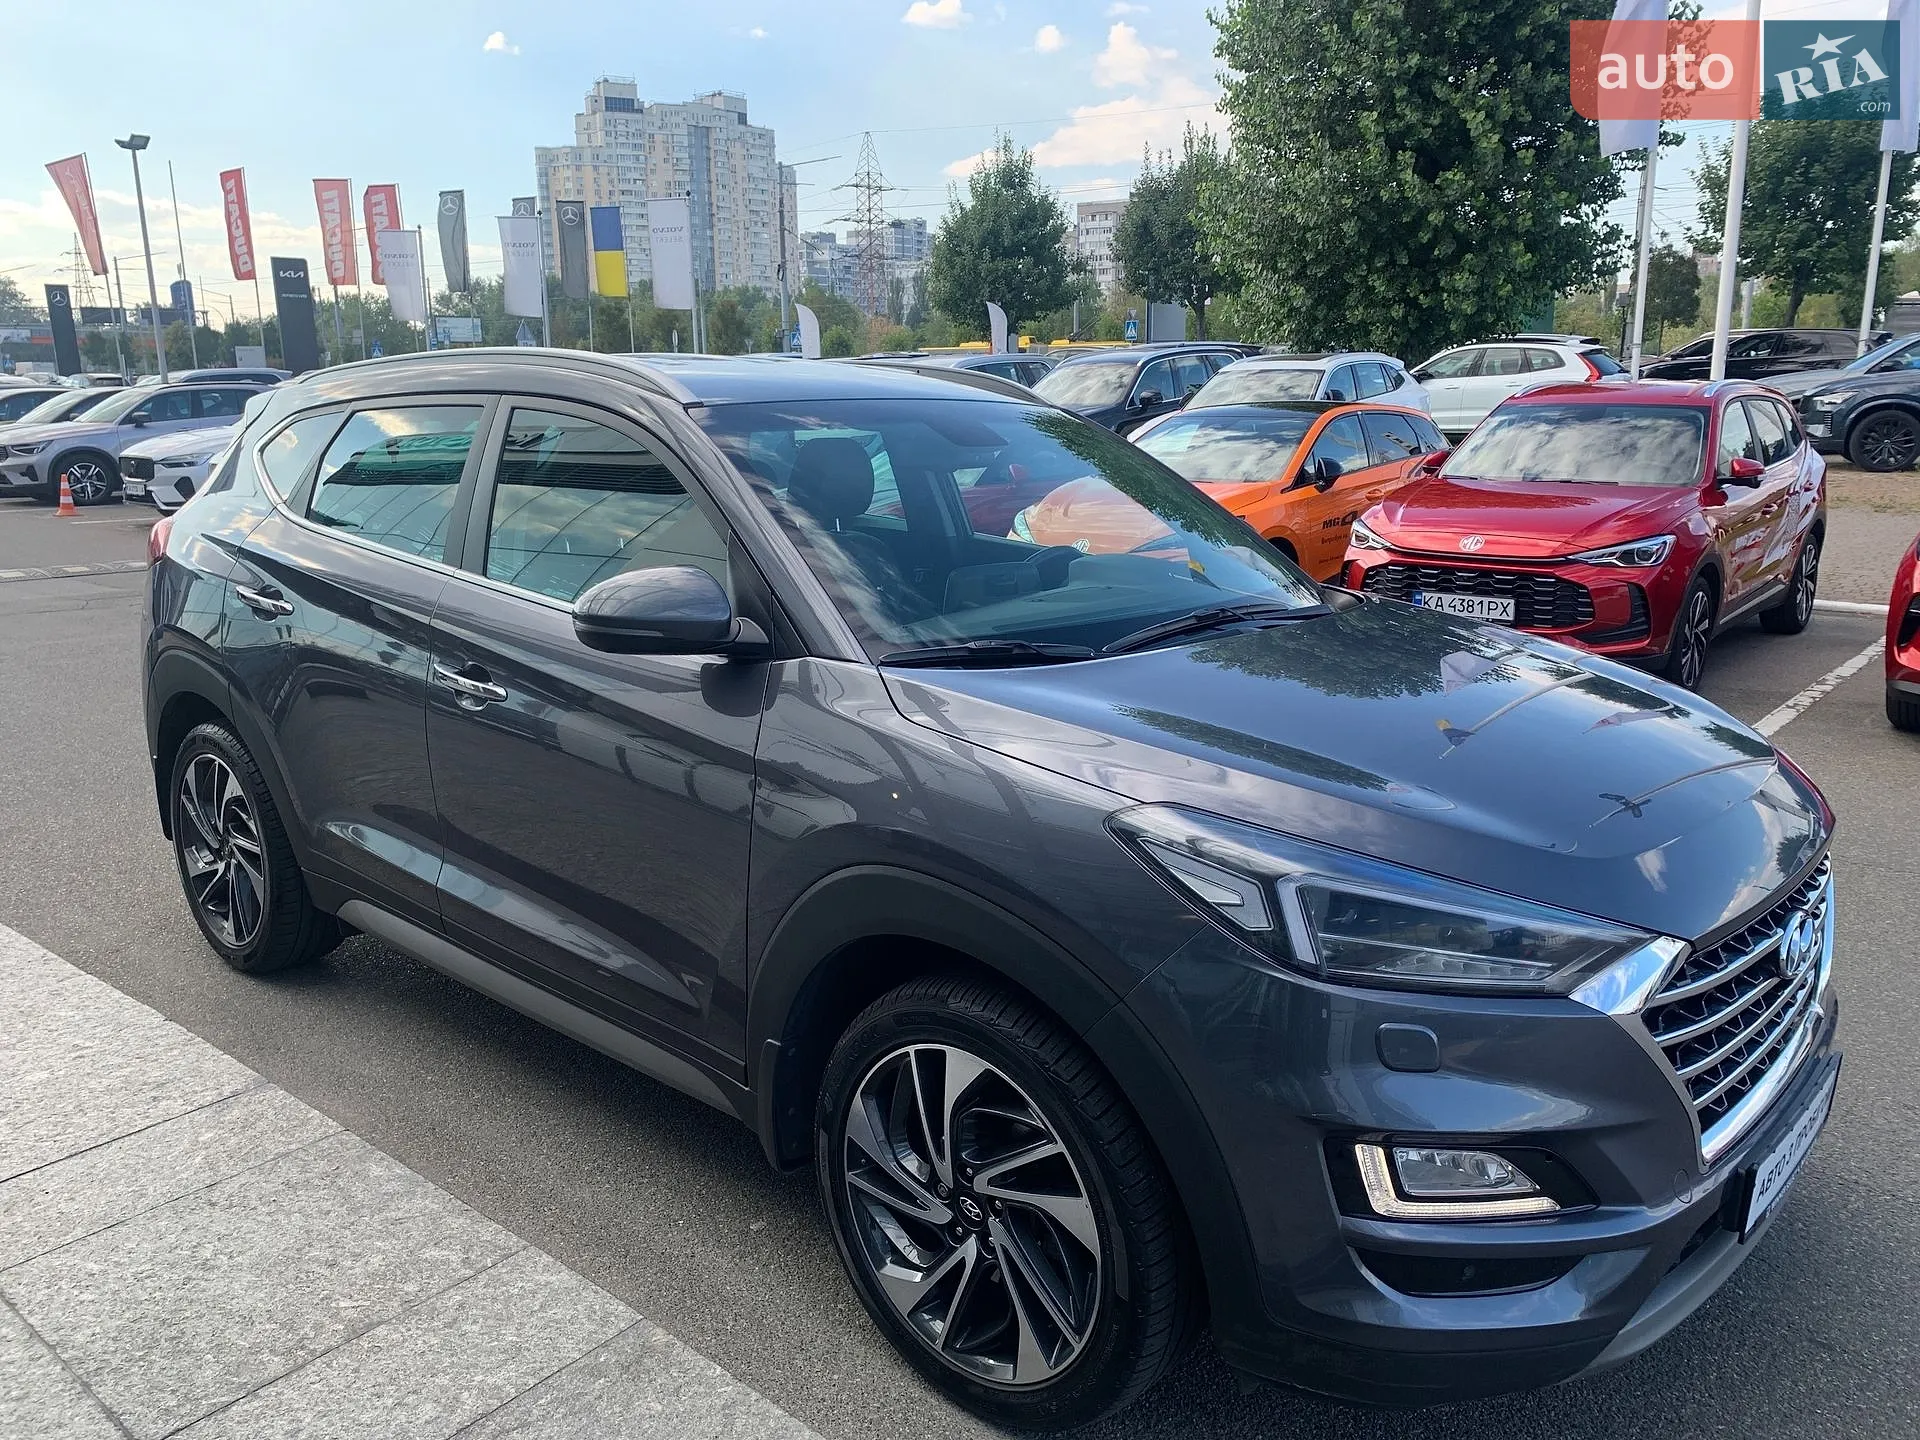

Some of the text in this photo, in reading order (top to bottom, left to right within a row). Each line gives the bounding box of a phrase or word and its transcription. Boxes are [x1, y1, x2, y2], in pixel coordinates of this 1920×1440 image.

[279, 270, 304, 278] KIA
[1460, 536, 1484, 551] MG
[1423, 595, 1444, 611] KA
[1757, 1154, 1786, 1203] АВТО
